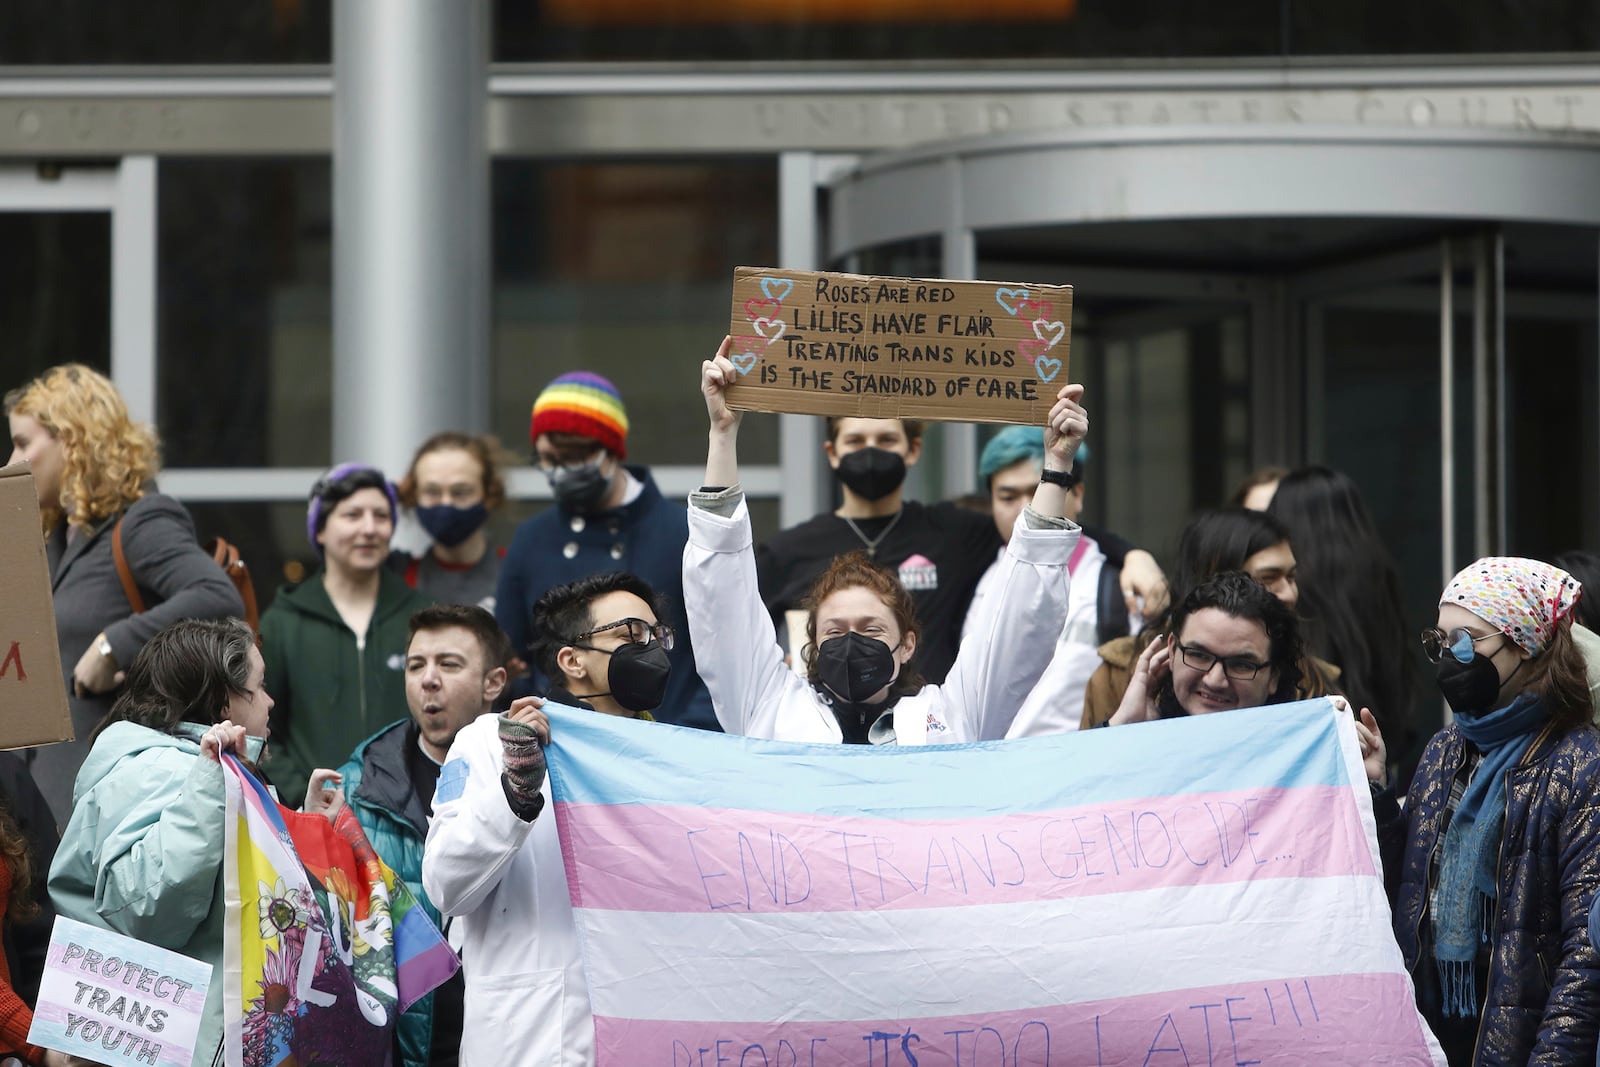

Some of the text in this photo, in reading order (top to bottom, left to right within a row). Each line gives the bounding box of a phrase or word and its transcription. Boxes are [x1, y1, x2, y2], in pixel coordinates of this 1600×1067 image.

[753, 103, 1013, 138] UNITED
[1065, 101, 1303, 126] STATES
[815, 277, 955, 303] ROSES ARE RED
[873, 312, 928, 335] HAVE
[884, 343, 954, 364] TRANS
[789, 366, 833, 391] THE
[840, 370, 937, 398] STANDARD
[945, 377, 970, 398] OF
[976, 378, 1039, 401] CARE
[687, 828, 811, 909] END
[825, 829, 1026, 907] TRANS
[61, 942, 193, 1005] PROTECT
[74, 981, 169, 1034] TRANS
[64, 1013, 162, 1067] YOUTH
